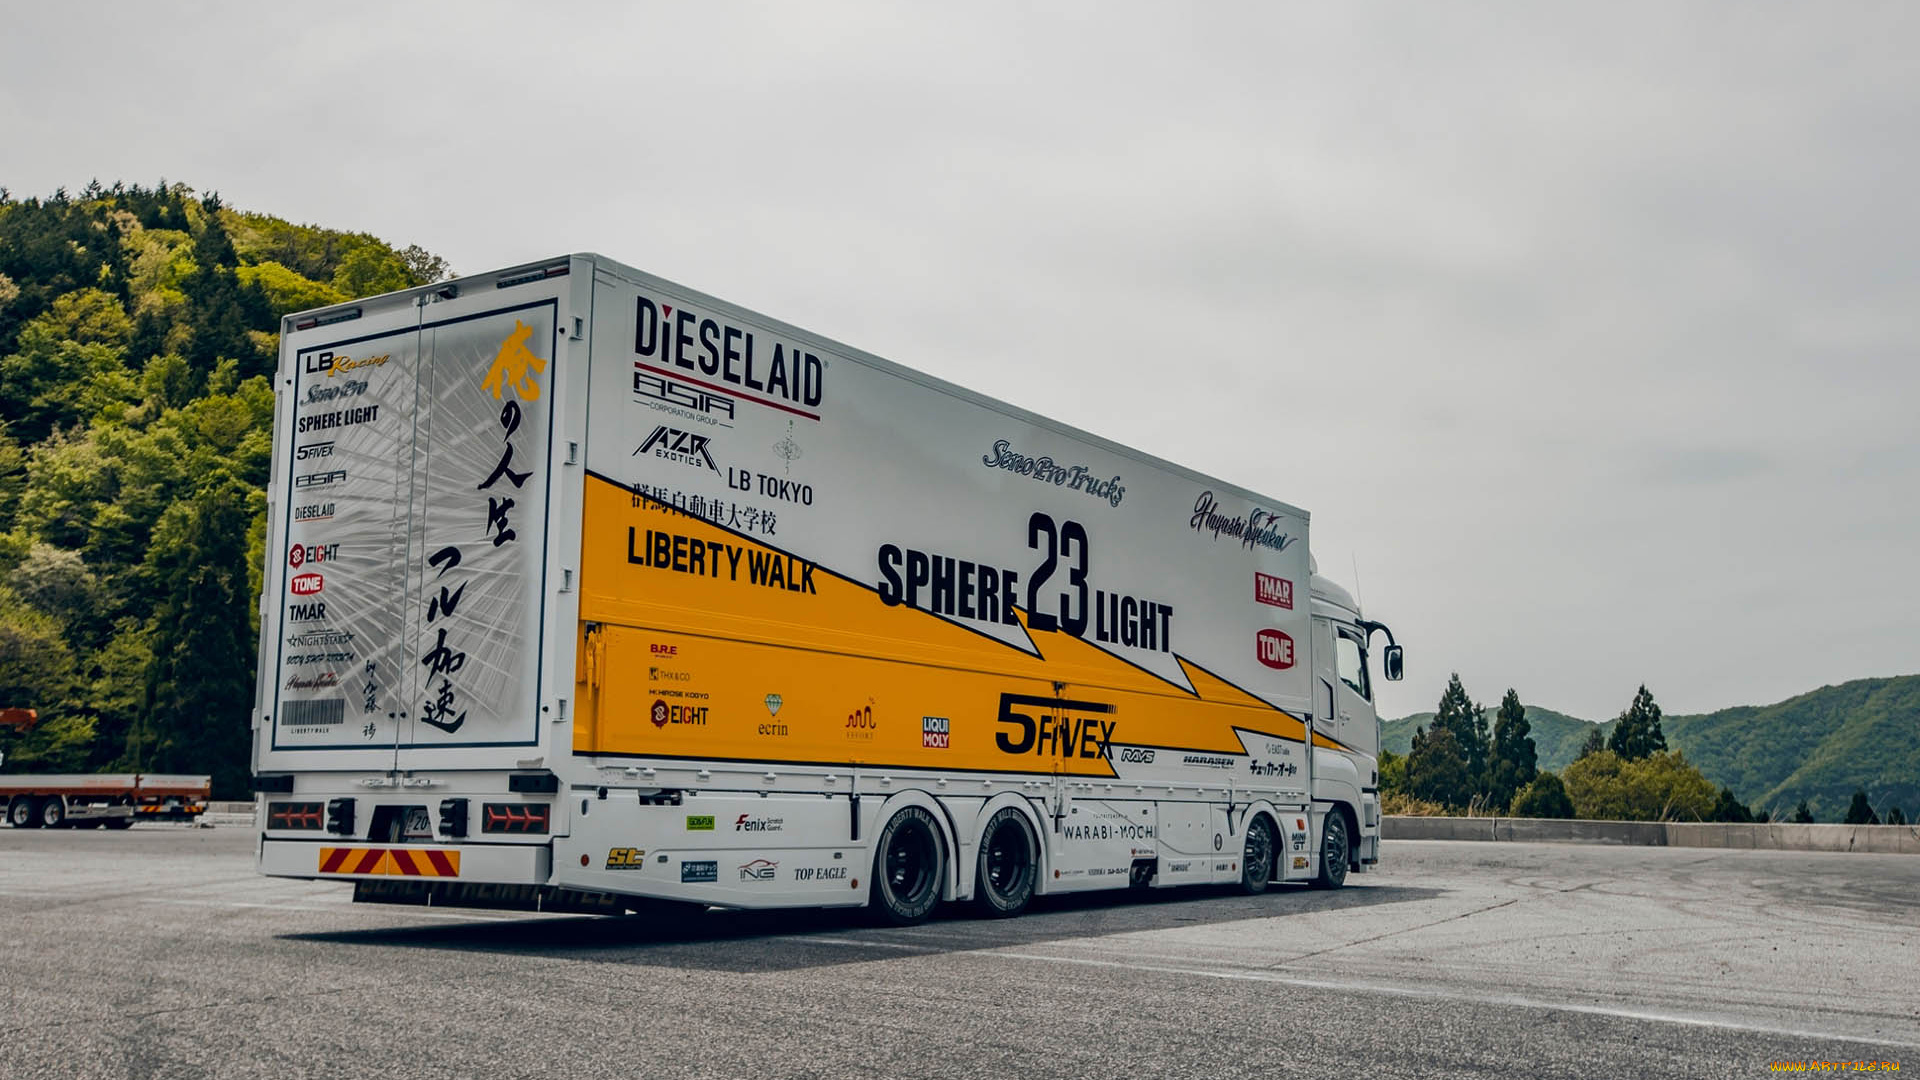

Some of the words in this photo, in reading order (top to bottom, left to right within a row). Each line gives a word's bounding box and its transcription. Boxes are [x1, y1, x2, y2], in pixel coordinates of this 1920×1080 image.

[306, 352, 334, 374] LB
[328, 354, 390, 377] Racing
[339, 380, 368, 398] Pro
[633, 371, 735, 420] ASIA
[299, 411, 342, 433] SPHERE
[344, 405, 379, 426] LIGHT
[650, 401, 696, 421] CORPORATION
[696, 414, 719, 426] GROUP
[656, 449, 702, 467] EXOTICS
[296, 470, 346, 488] ASIA
[982, 439, 1035, 476] Seno
[1033, 456, 1067, 485] Pro
[1067, 465, 1126, 508] Trucks
[729, 467, 750, 491] LB
[757, 474, 813, 506] TOKYO
[632, 483, 777, 535] 群馬自動車大学校
[1190, 491, 1247, 542] Hayashi
[306, 544, 339, 563] EIGHT
[628, 526, 743, 581] LIBERTY
[747, 549, 817, 595] WALK
[293, 577, 321, 592] TONE
[878, 543, 1018, 626] SPHERE
[1027, 512, 1089, 638] 23
[1096, 590, 1173, 653] LIGHT
[1258, 574, 1291, 604] TMAR
[289, 603, 326, 621] TMAR
[1259, 634, 1291, 664] TONE
[671, 705, 708, 724] EIGHT
[758, 719, 788, 735] ecrin
[923, 718, 949, 732] LIQUI
[924, 733, 949, 747] MOLY
[1121, 748, 1155, 763] RAYS
[736, 814, 766, 832] Fenix
[1064, 825, 1158, 840] WARABI-MOCHI
[1292, 832, 1306, 841] MINI
[1294, 841, 1305, 850] GT
[740, 867, 775, 879] ING
[795, 868, 814, 880] TOP
[816, 868, 847, 880] EAGLE
